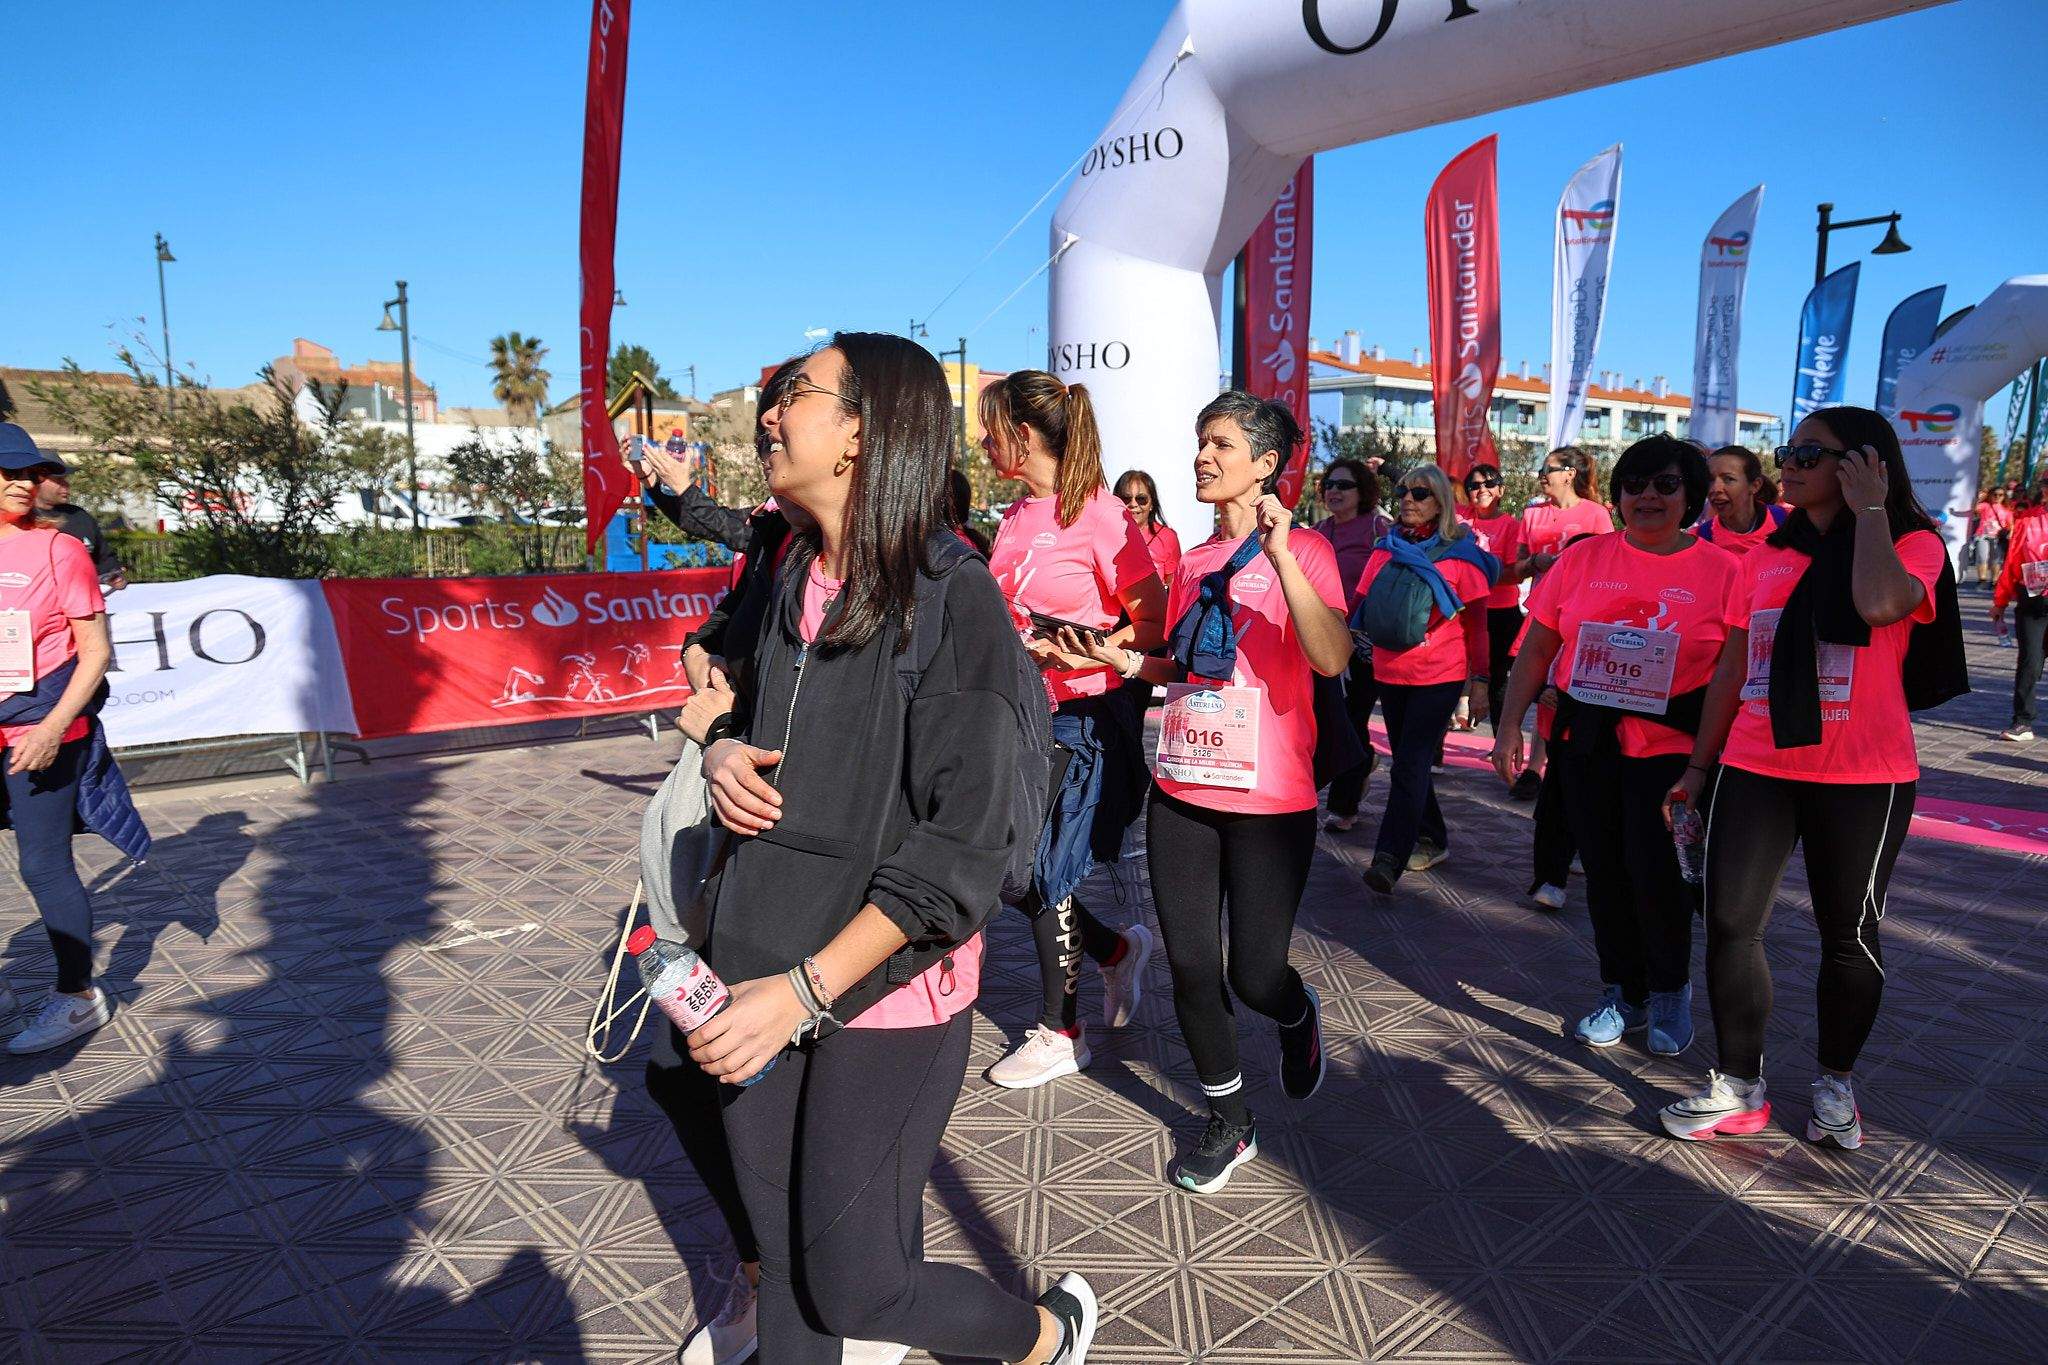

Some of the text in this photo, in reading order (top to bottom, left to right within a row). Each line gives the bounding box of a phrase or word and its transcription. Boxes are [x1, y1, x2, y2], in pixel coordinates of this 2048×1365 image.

[1081, 126, 1184, 177] OYSHO
[1451, 200, 1480, 358] Santander
[1048, 340, 1131, 373] YSHO
[381, 597, 526, 643] Sports
[1605, 660, 1642, 678] 016
[1186, 728, 1224, 747] 016
[1192, 749, 1212, 758] 5126
[1056, 894, 1083, 995] adidas
[685, 975, 712, 1007] ZERO
[691, 982, 718, 1013] SODIO
